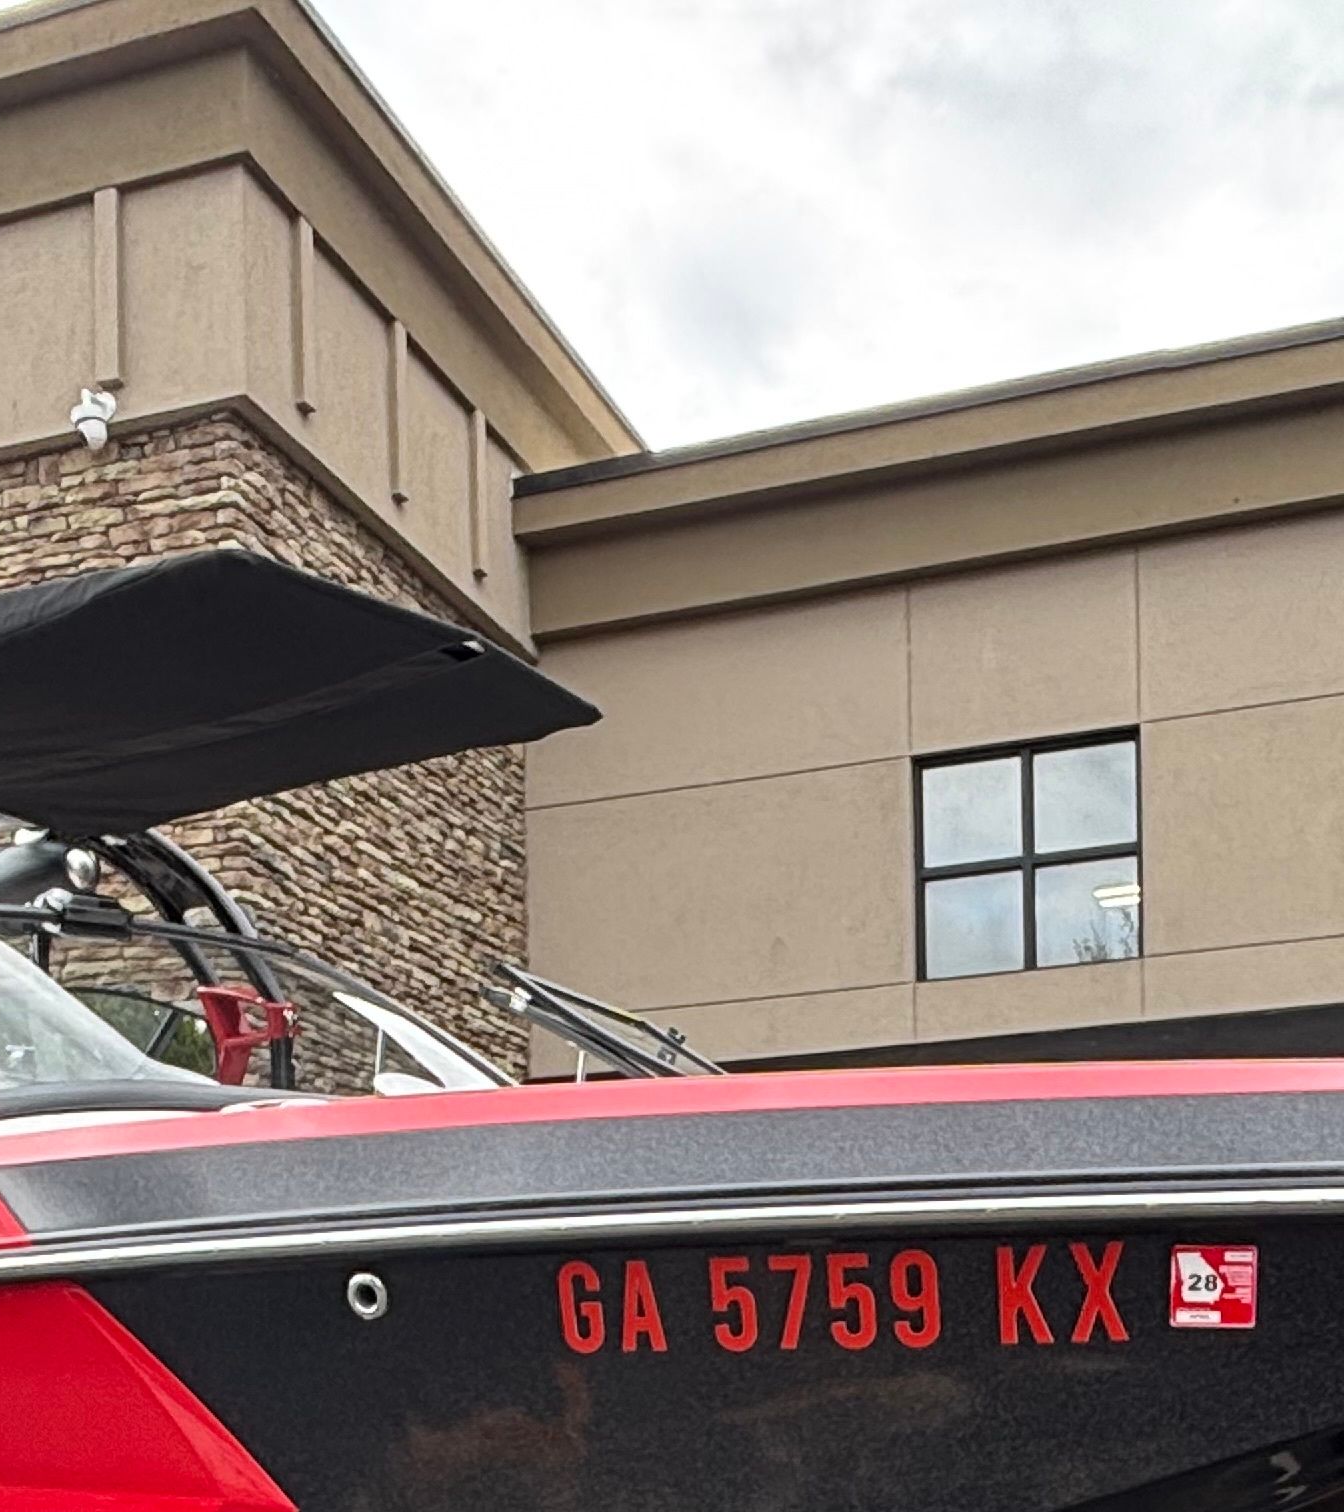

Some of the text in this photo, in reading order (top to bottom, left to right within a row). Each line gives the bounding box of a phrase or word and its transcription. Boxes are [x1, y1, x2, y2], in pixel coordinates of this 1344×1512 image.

[556, 1241, 1131, 1354] GA 5759 KX
[1188, 1273, 1218, 1292] 28
